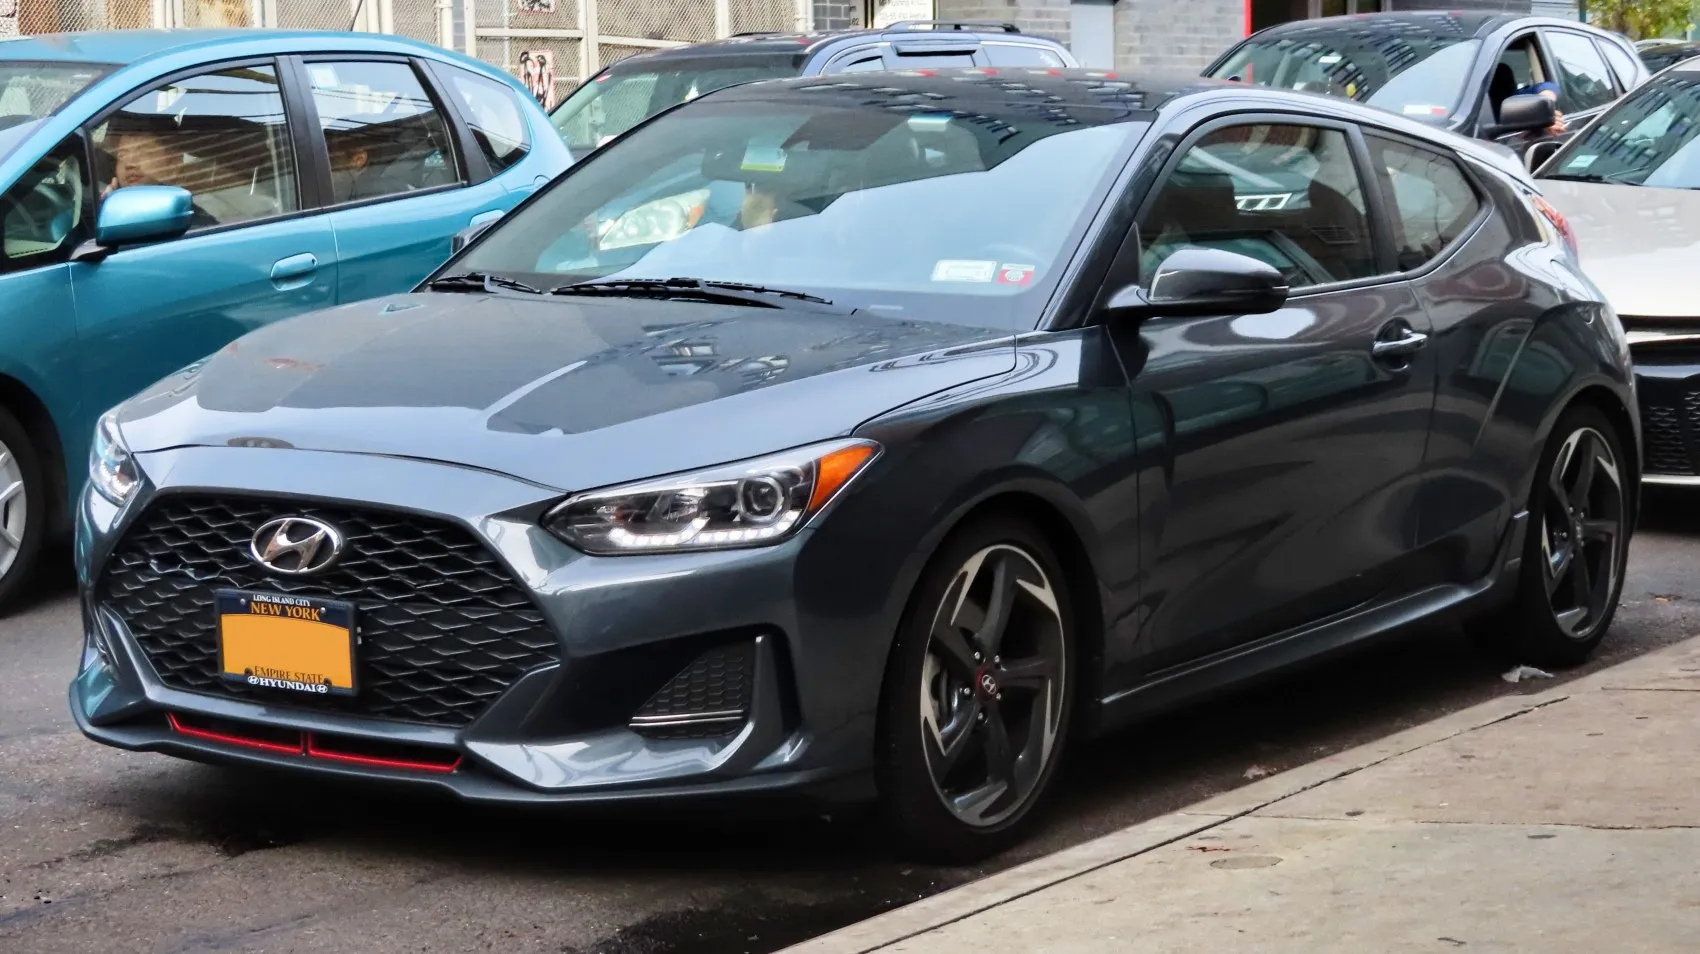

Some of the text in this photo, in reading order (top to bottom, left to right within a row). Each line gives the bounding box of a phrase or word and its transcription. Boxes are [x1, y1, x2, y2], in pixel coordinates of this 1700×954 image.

[253, 594, 311, 607] LONG ISLAND CITY
[250, 601, 321, 621] NEW YORK
[254, 665, 323, 685] EMPIRE STATE
[259, 677, 317, 693] HYUNDAI
